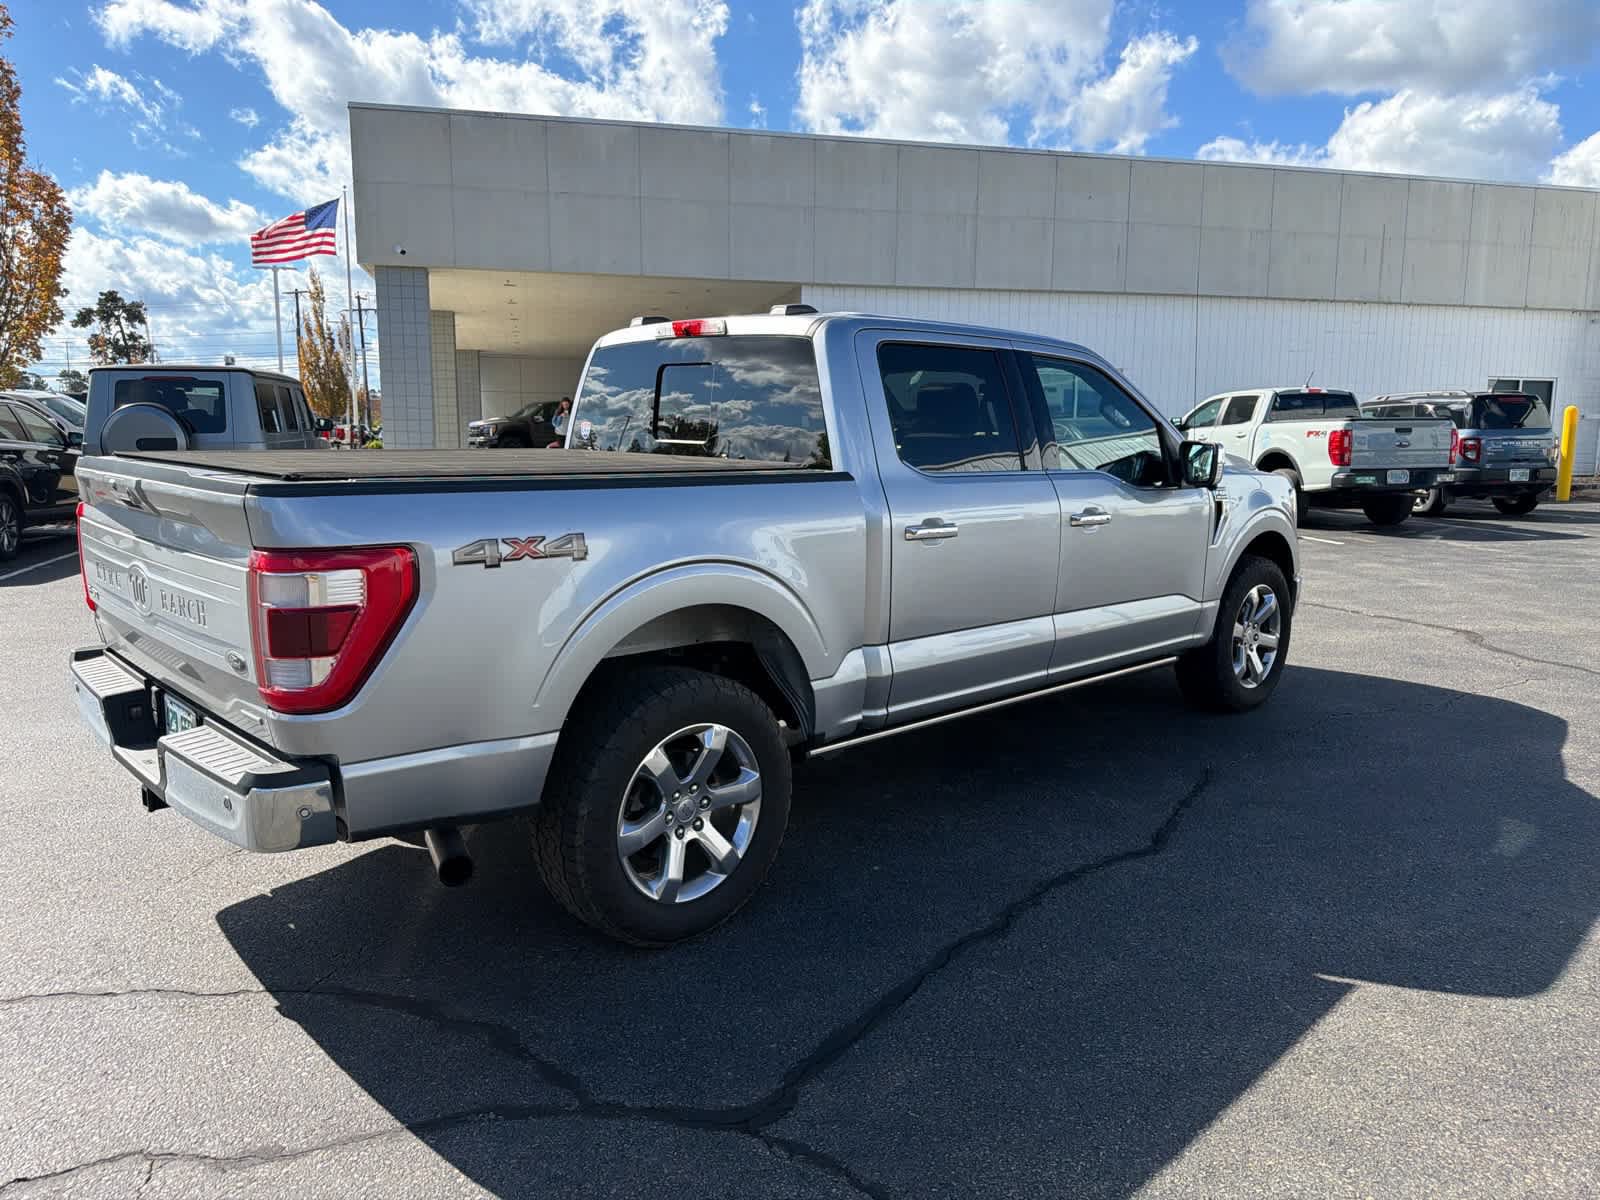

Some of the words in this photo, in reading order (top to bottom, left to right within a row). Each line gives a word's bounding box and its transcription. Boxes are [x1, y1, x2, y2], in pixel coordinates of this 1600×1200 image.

[1306, 430, 1328, 439] FX4
[452, 532, 588, 568] 4X4
[159, 589, 208, 628] RANCH
